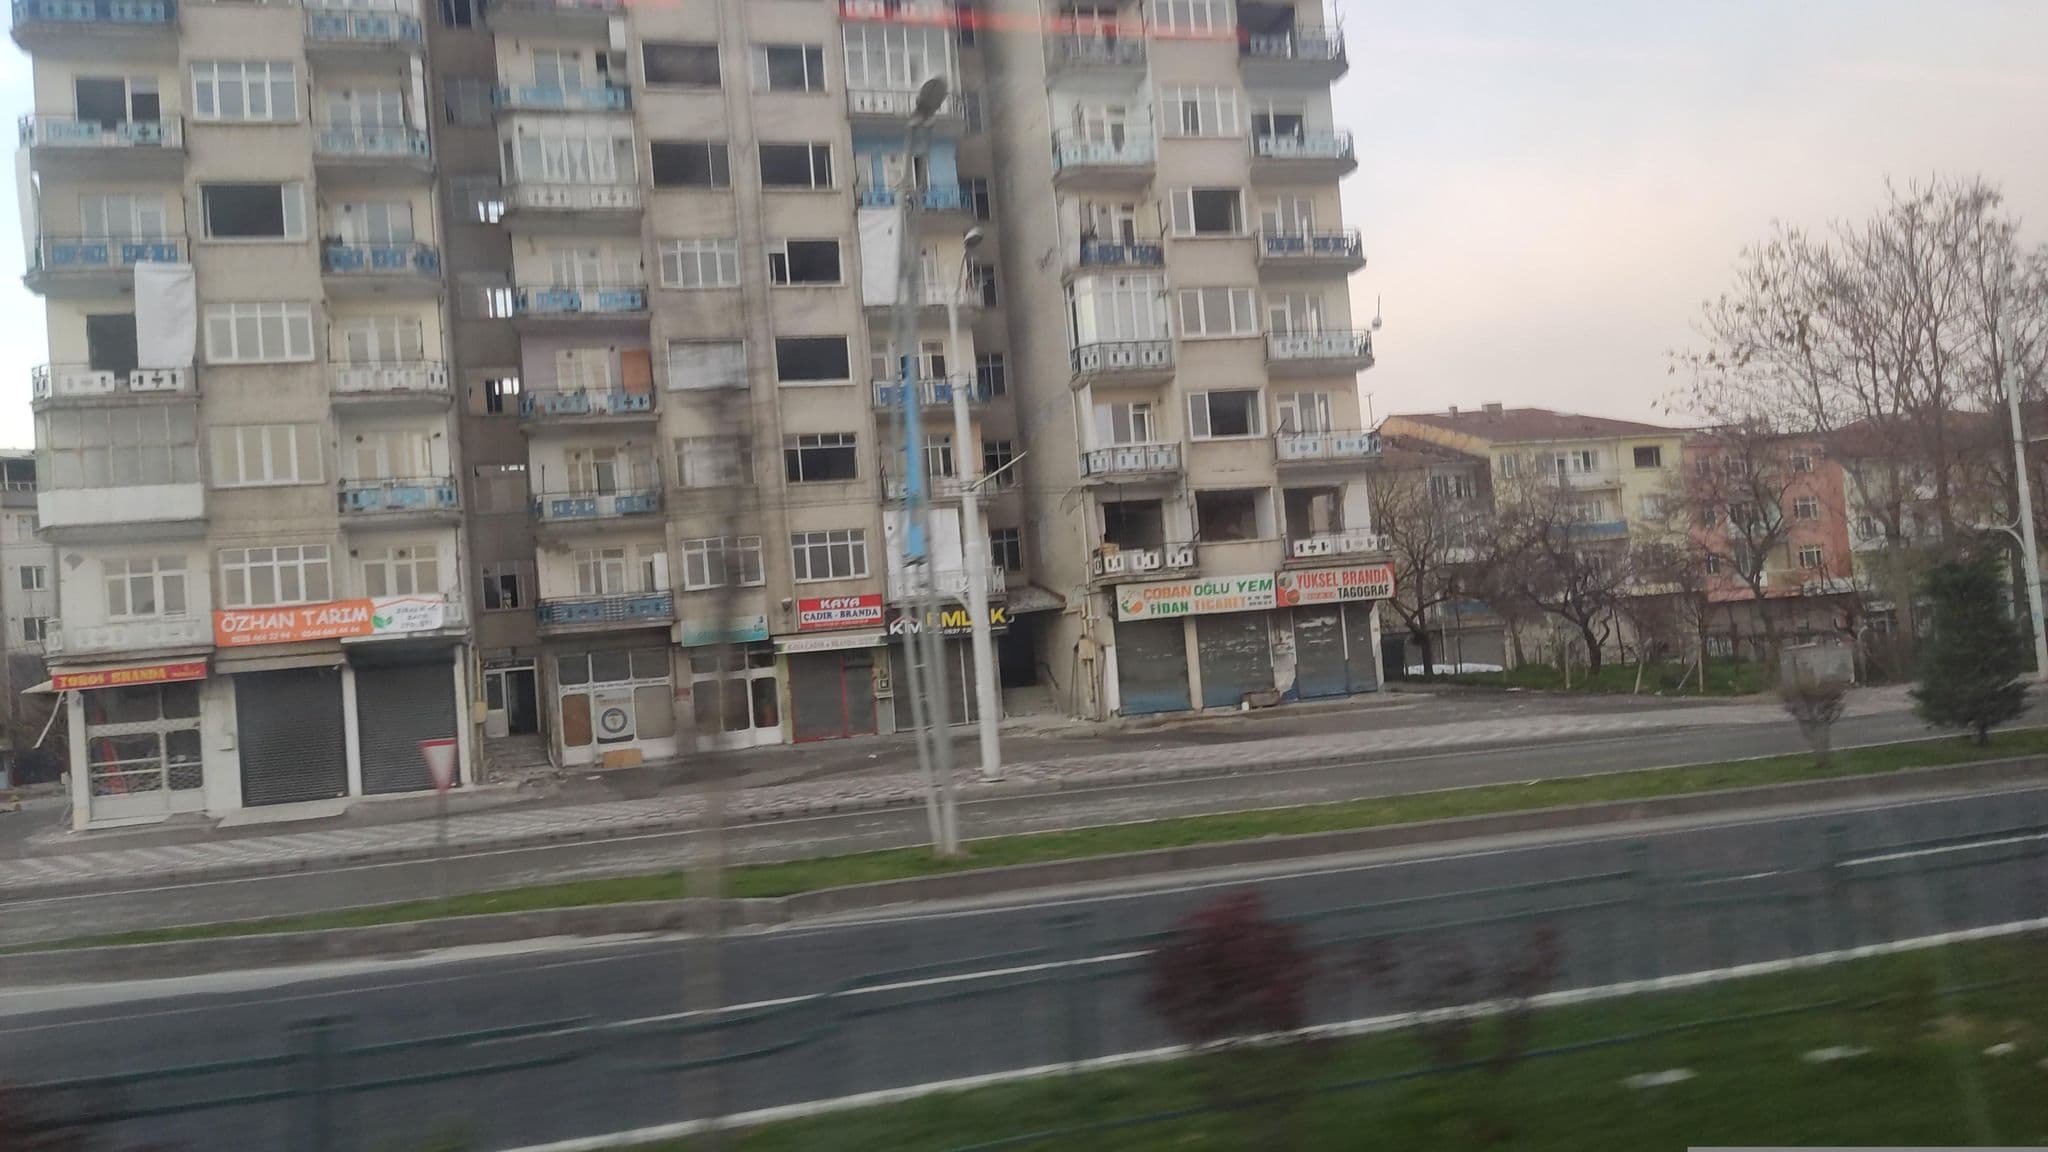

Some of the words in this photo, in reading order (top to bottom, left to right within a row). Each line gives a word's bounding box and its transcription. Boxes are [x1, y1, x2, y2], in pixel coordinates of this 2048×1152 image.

[1237, 579, 1273, 593] YEM
[1296, 571, 1338, 590] YÜKSEL
[1342, 568, 1389, 586] BRANDA
[820, 597, 860, 609] KAYA
[221, 611, 296, 633] ÖZHAN
[301, 607, 369, 626] TARIM
[840, 608, 878, 618] BRANDA
